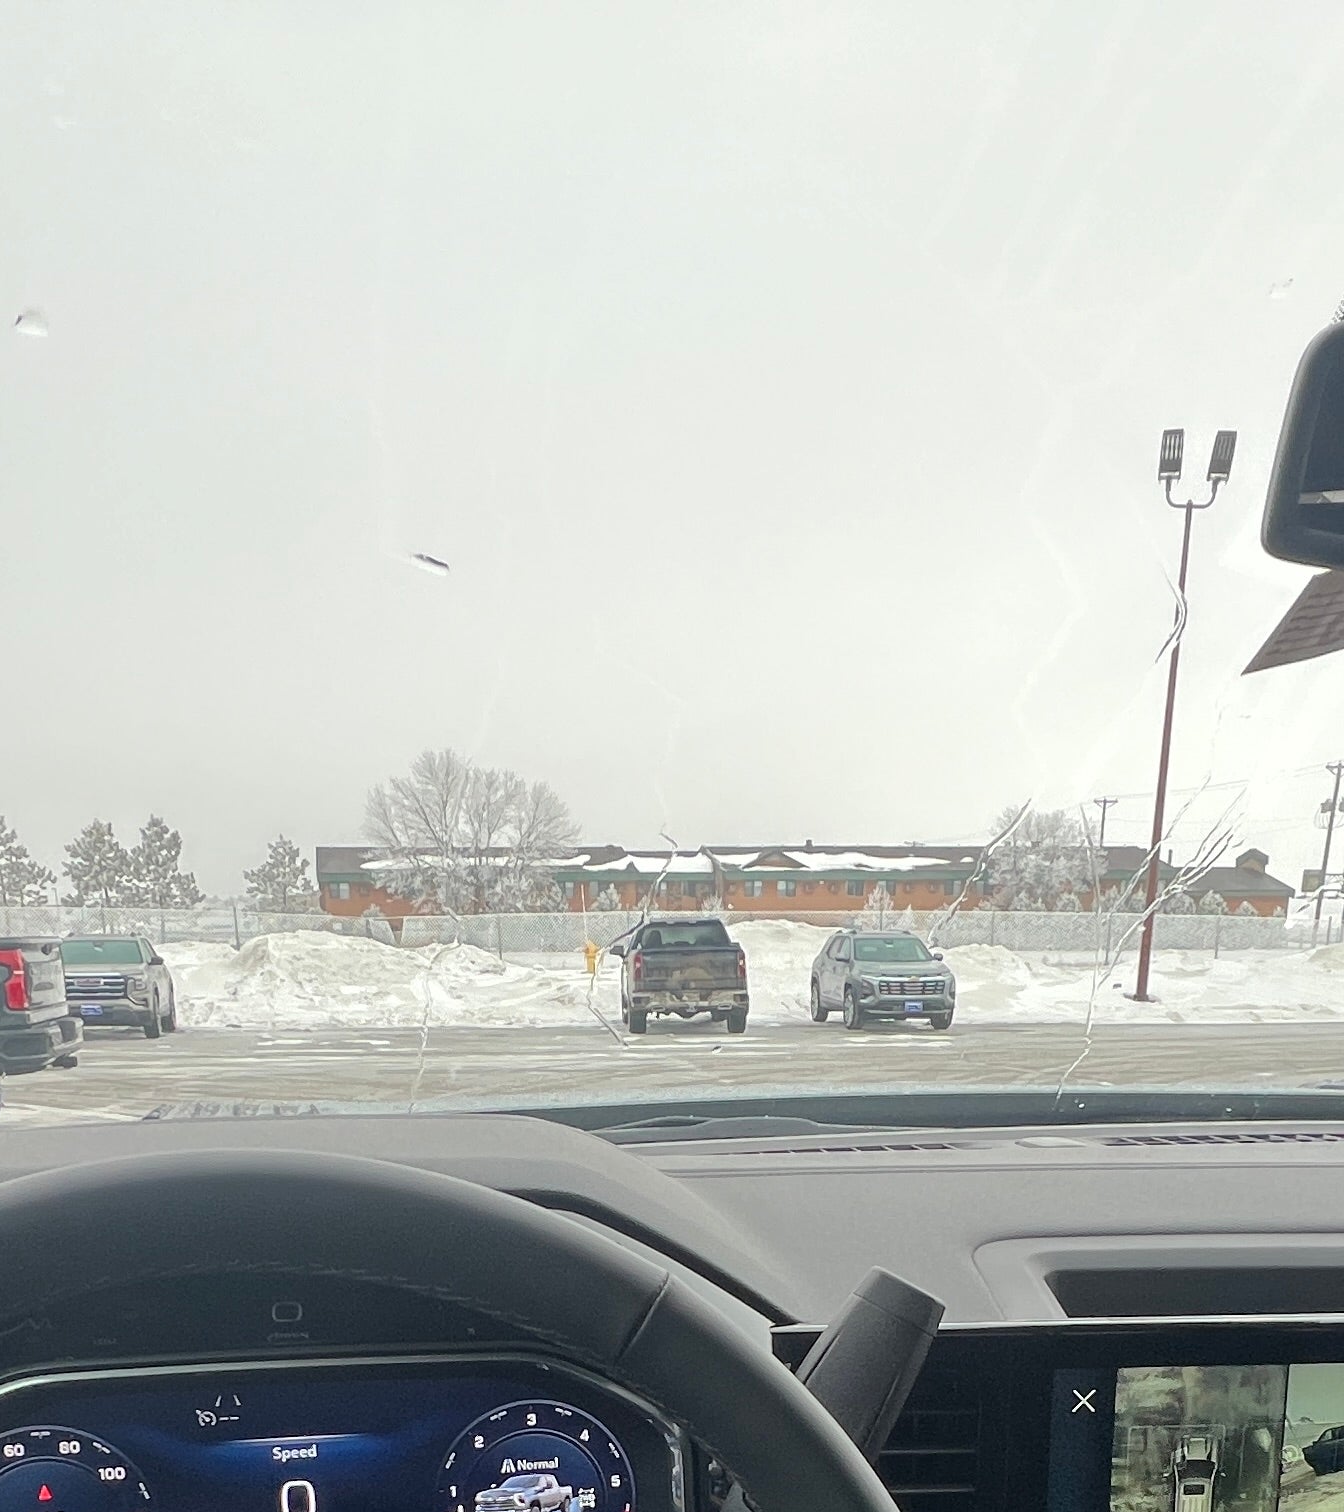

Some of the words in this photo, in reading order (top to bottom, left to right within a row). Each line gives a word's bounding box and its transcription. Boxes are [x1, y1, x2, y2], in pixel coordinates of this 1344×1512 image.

[526, 1413, 537, 1427] 3
[474, 1435, 485, 1448] 2
[579, 1429, 590, 1442] 4
[3, 1444, 25, 1457] 60
[58, 1441, 81, 1454] 80
[272, 1444, 317, 1462] Speed
[517, 1457, 559, 1471] Normal
[98, 1467, 126, 1480] 100
[611, 1475, 621, 1487] 5
[449, 1486, 457, 1498] 1
